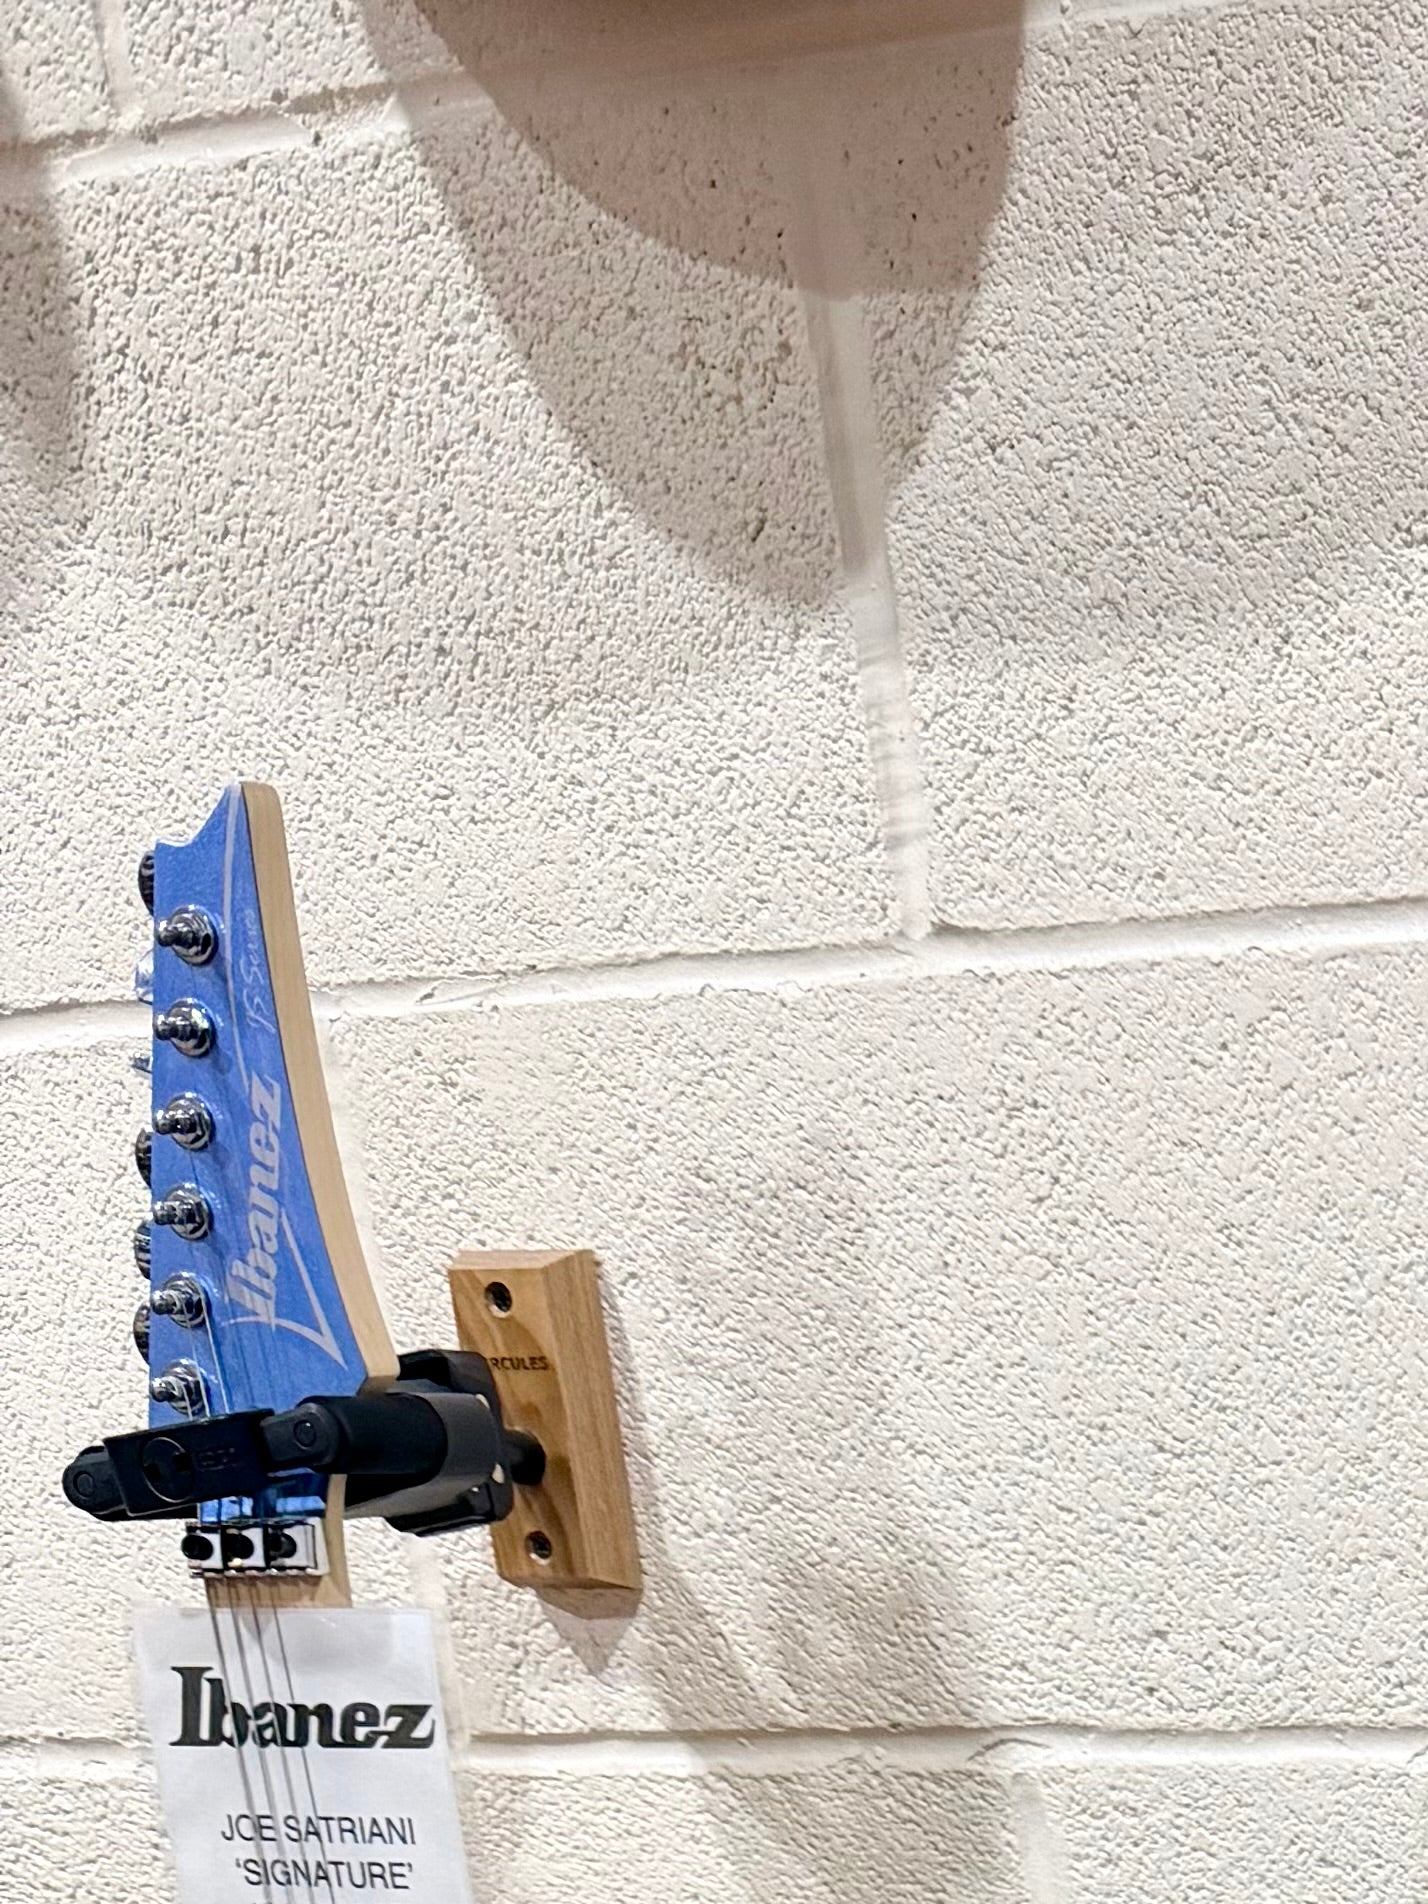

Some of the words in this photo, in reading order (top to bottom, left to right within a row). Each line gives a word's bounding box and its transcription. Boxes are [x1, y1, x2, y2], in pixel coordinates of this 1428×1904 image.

[226, 1072, 283, 1322] Ibanez
[489, 1356, 549, 1370] RCULES
[169, 1665, 436, 1749] Ibanez
[220, 1814, 276, 1844] JOE
[283, 1815, 417, 1846] SATRIANI
